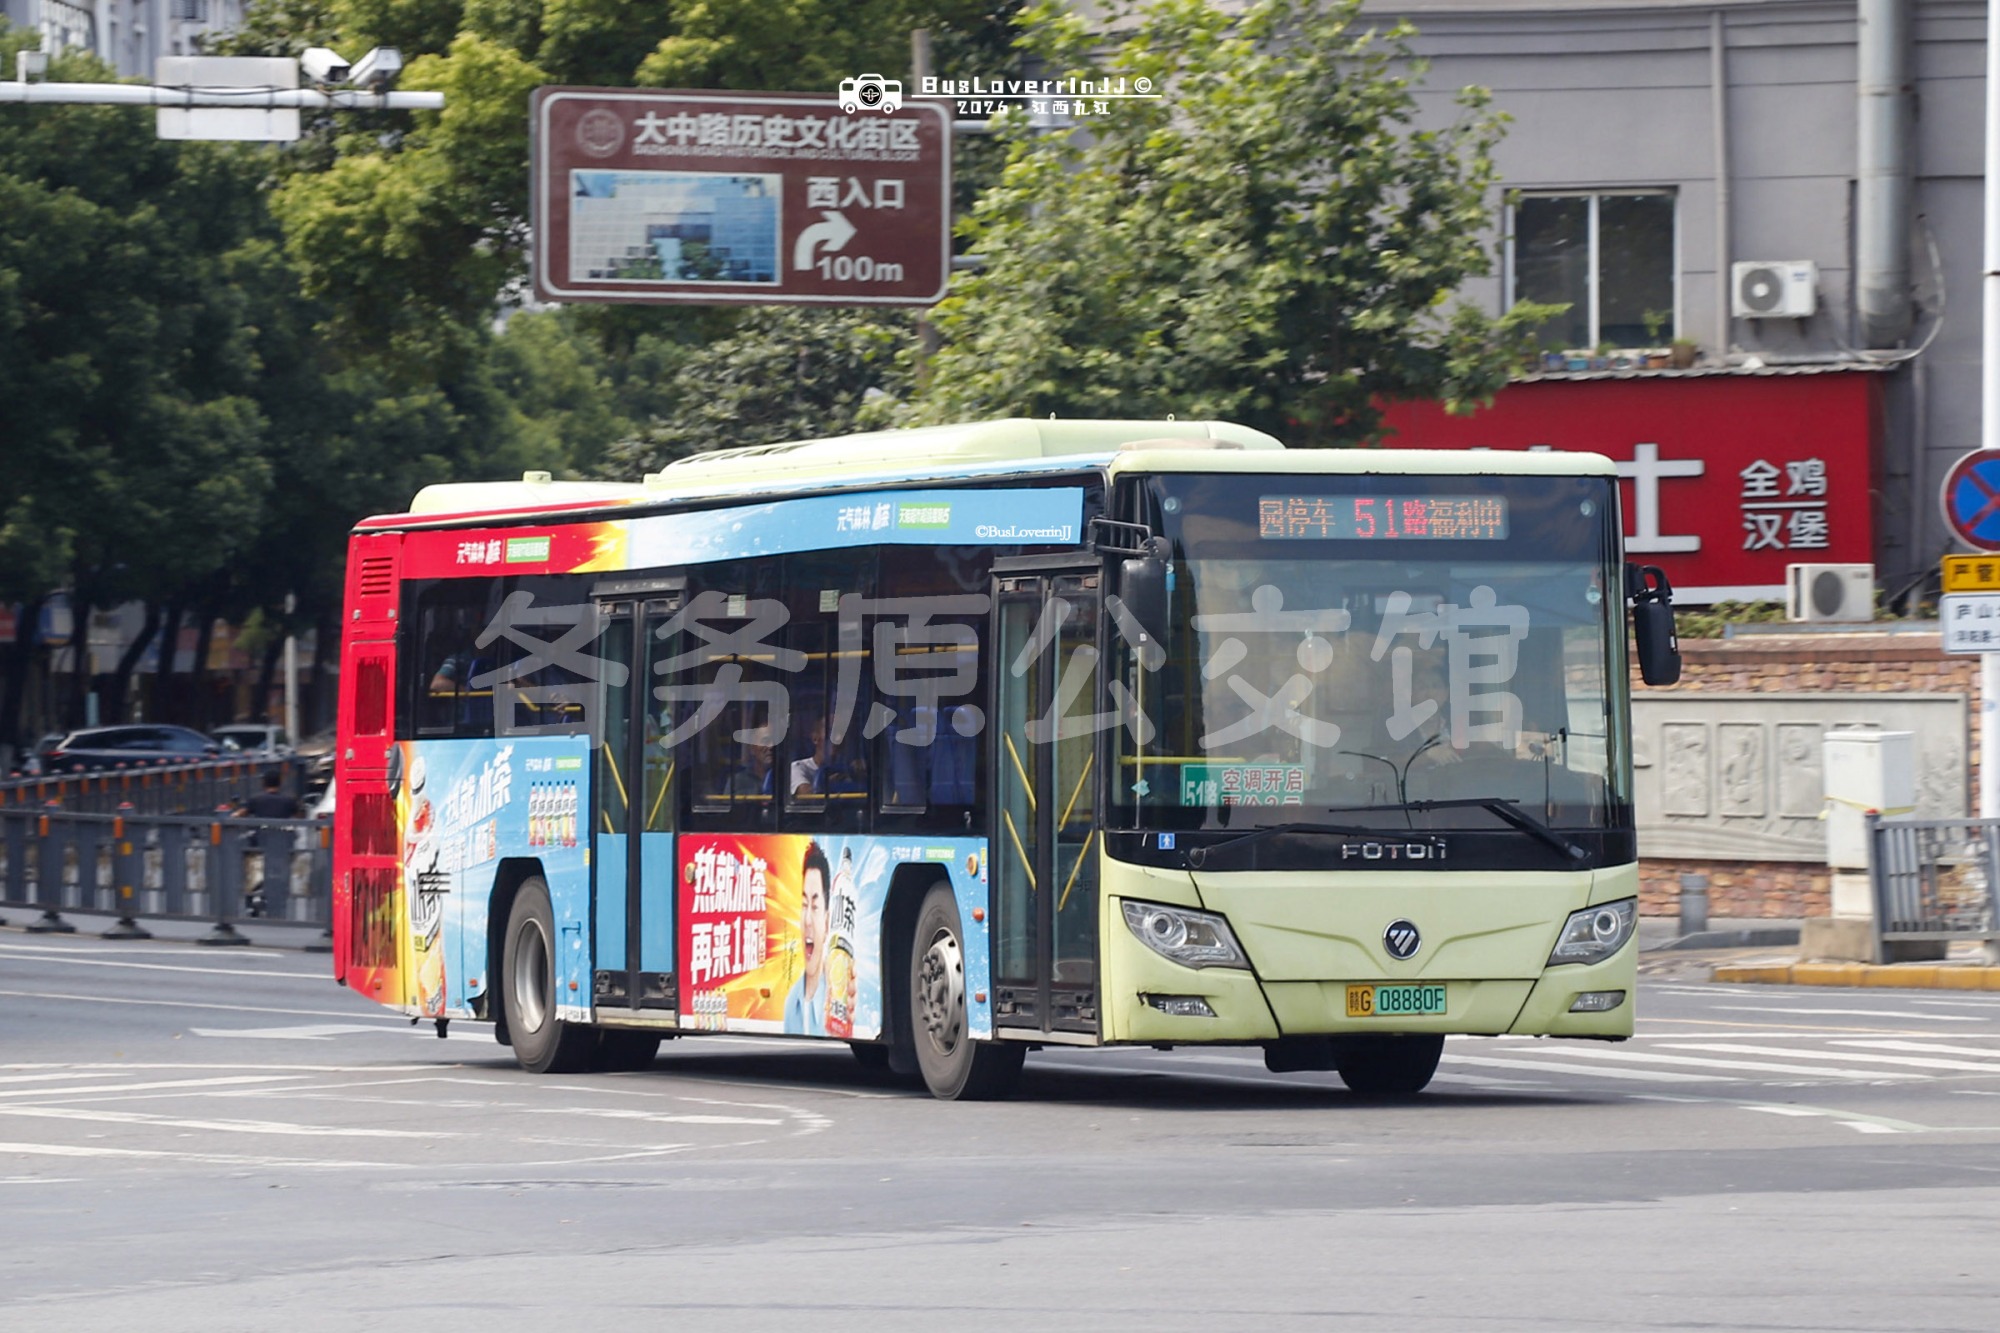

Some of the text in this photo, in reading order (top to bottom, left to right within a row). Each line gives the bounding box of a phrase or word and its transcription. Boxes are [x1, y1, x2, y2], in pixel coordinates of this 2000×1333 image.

[634, 111, 920, 149] 大中路历史文化街区
[806, 176, 905, 209] 西入口
[816, 255, 904, 282] 100m
[1740, 457, 1828, 497] 全鸡
[1742, 510, 1830, 550] 汉堡
[1222, 769, 1303, 792] 空调开启
[690, 916, 760, 985] 再来1瓶
